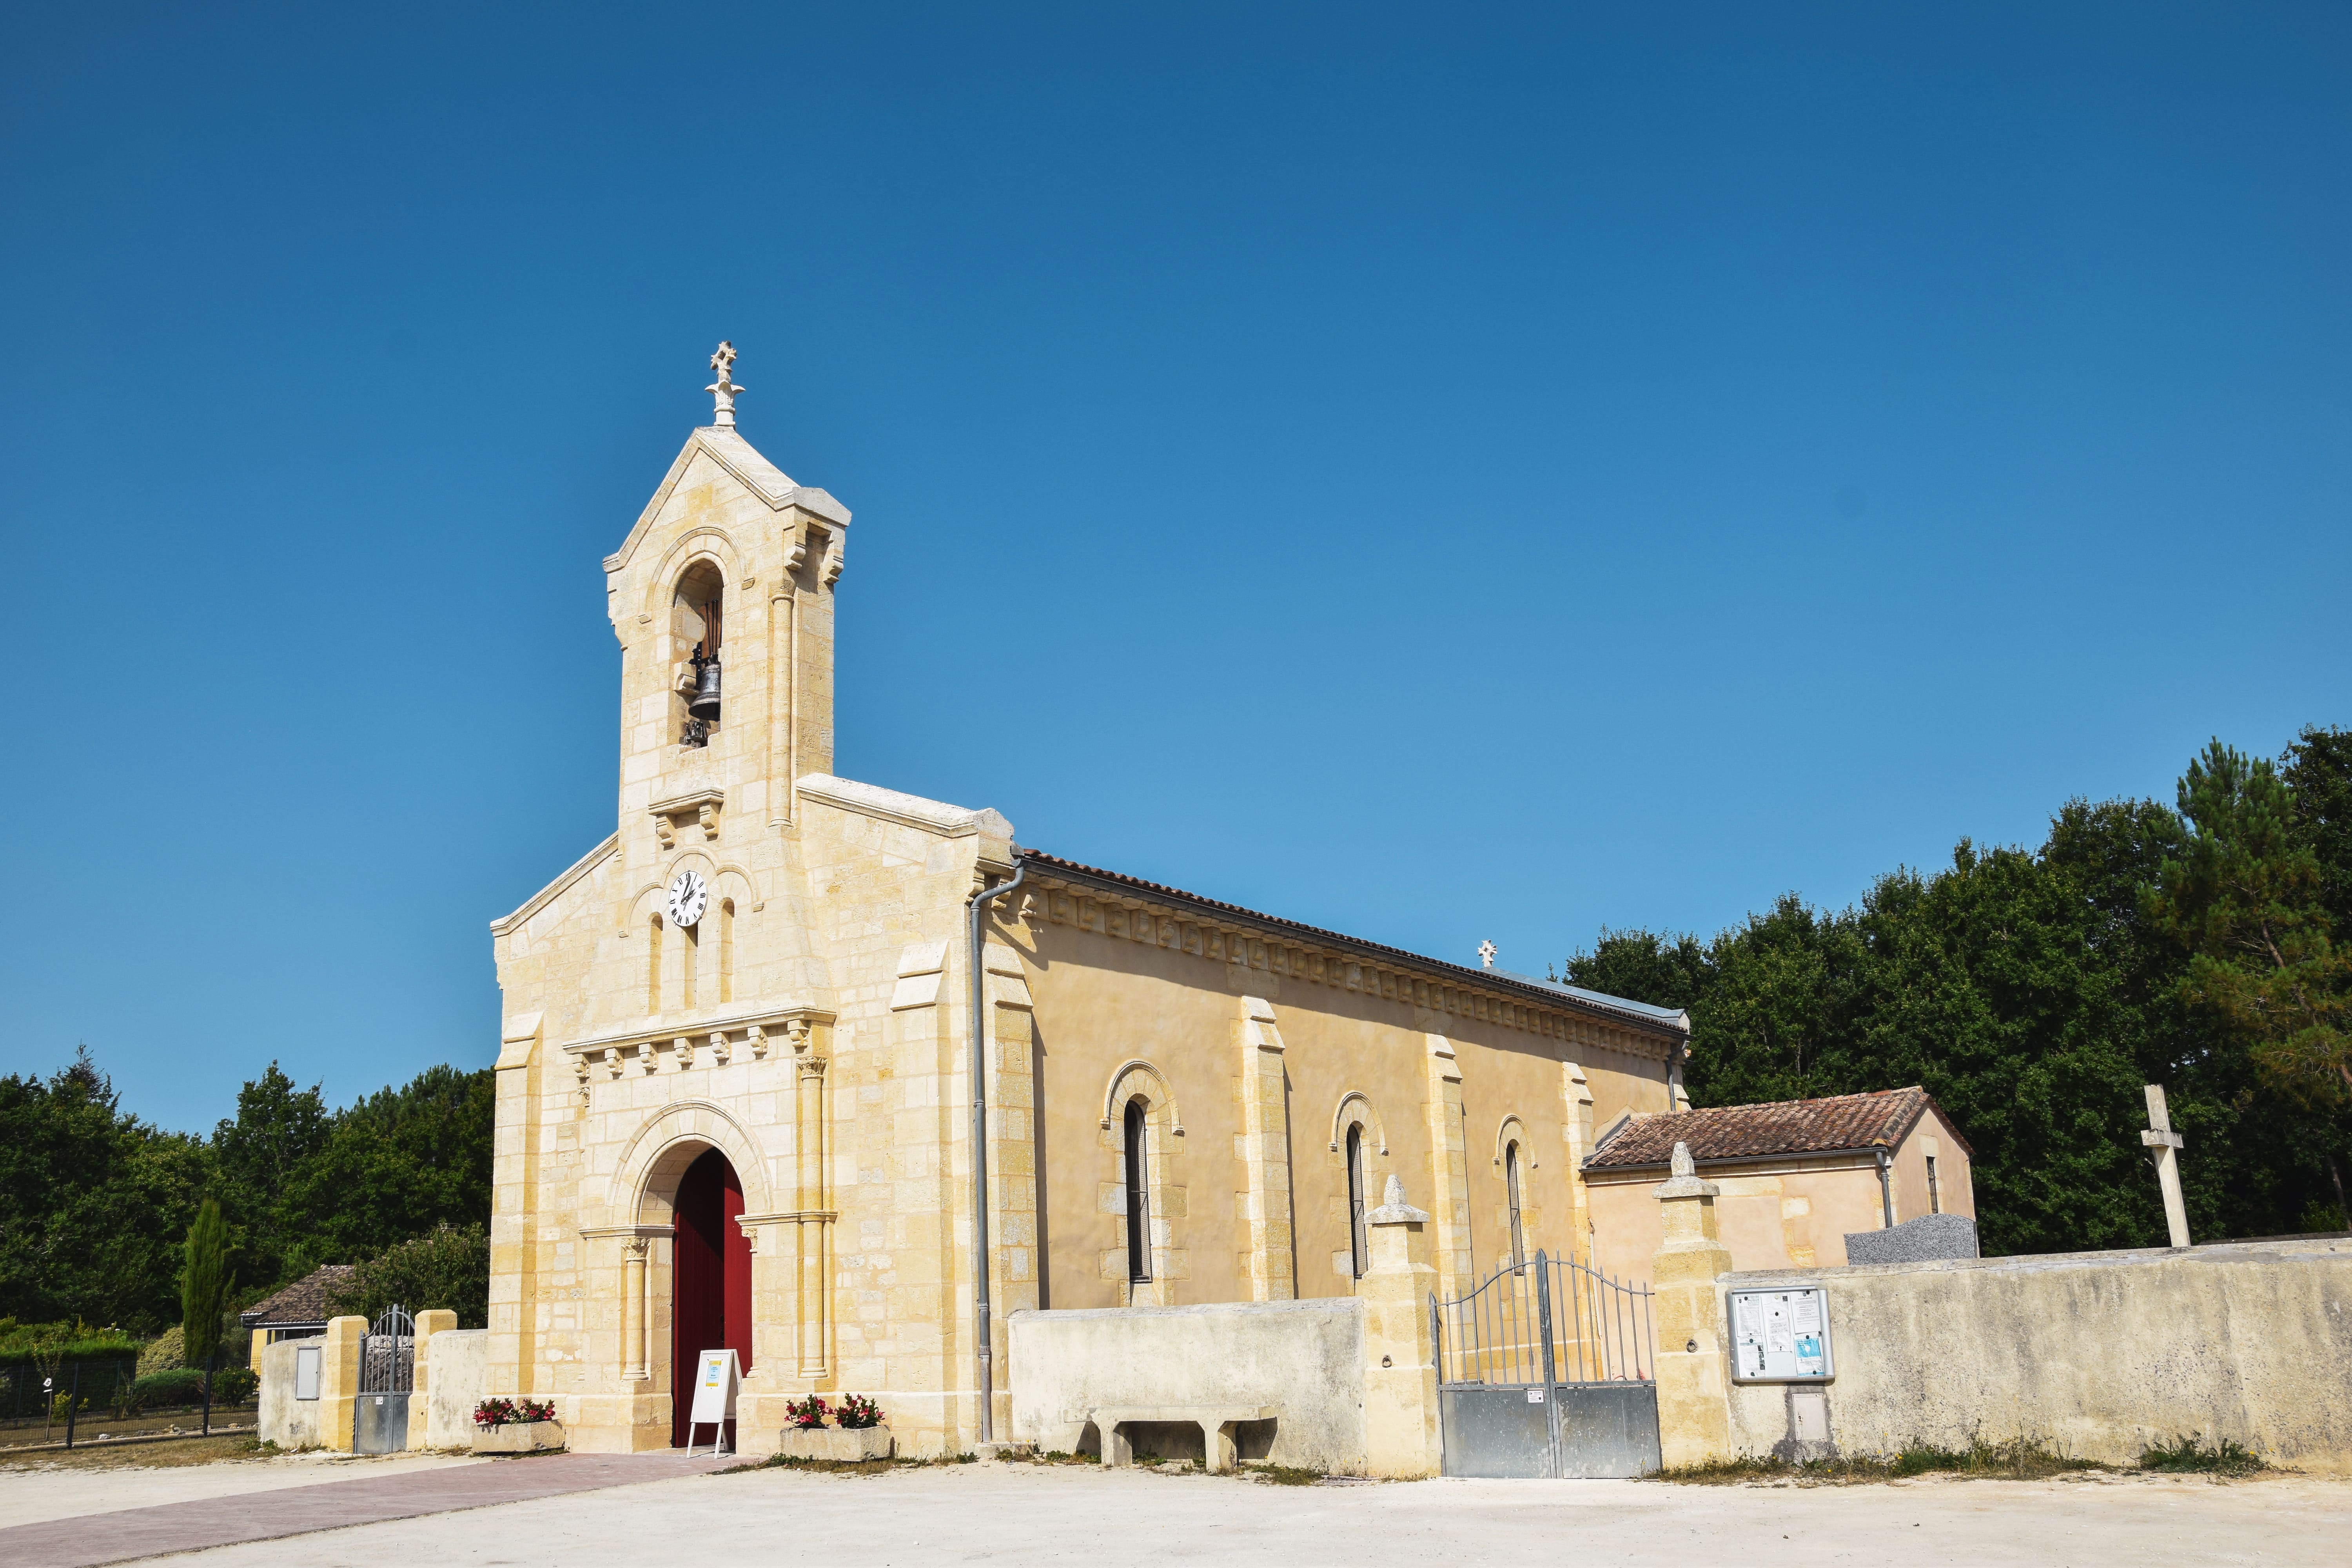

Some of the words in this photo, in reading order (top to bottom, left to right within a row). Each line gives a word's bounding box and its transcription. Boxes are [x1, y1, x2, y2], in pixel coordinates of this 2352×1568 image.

[677, 877, 683, 886] XI
[693, 873, 697, 882] I
[685, 916, 689, 926] VI
